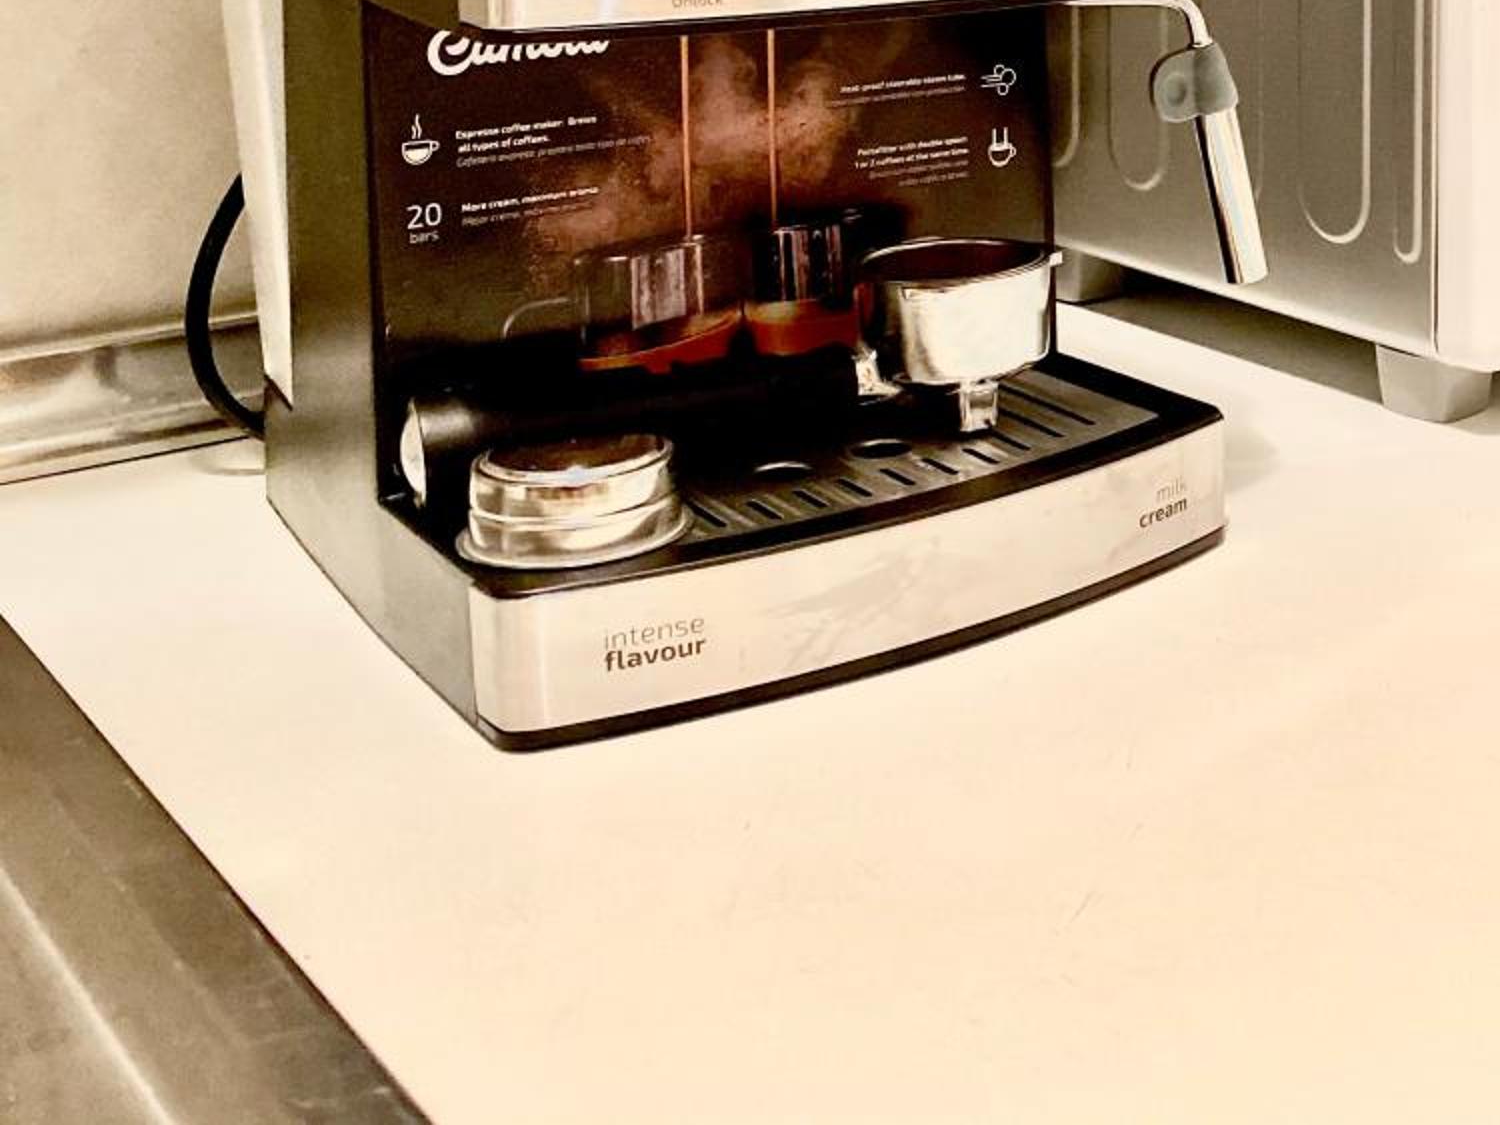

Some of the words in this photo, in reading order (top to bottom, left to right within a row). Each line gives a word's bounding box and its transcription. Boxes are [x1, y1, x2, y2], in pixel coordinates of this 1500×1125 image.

[407, 202, 442, 230] 20
[410, 230, 440, 244] bars
[1156, 475, 1187, 504] milk
[1139, 498, 1187, 528] cream
[604, 617, 705, 651] intense
[604, 638, 707, 672] flavour
